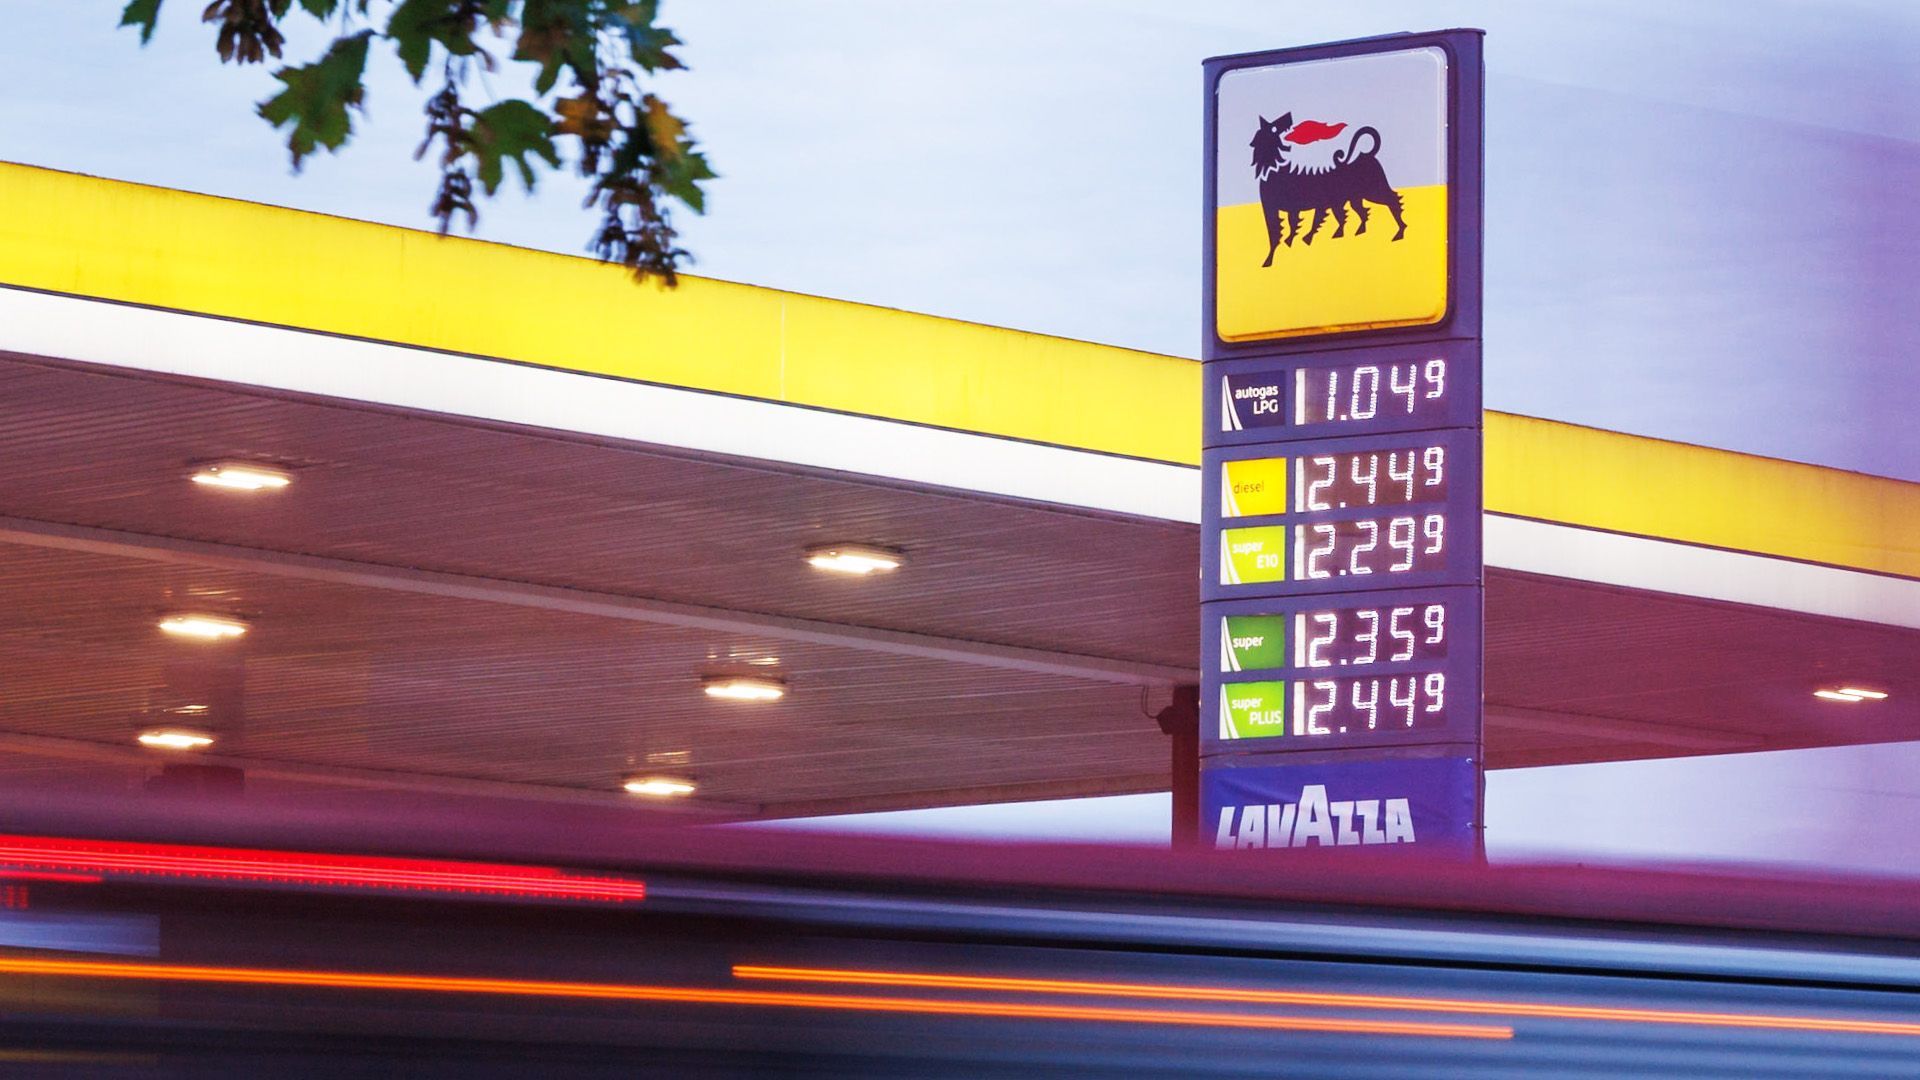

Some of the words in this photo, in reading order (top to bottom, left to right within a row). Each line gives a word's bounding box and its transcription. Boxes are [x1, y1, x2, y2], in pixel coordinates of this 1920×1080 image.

[1235, 385, 1278, 400] autogas
[1327, 359, 1445, 421] 1.049
[1253, 399, 1278, 415] LPG
[1308, 446, 1444, 511] 2.449
[1234, 480, 1264, 494] diesel
[1232, 541, 1264, 555] super
[1308, 514, 1444, 578] 2.299
[1257, 554, 1278, 569] E10
[1233, 635, 1264, 650] super
[1308, 605, 1445, 667] 2.359
[1231, 696, 1263, 710] super
[1308, 672, 1445, 735] 2.449
[1249, 710, 1281, 725] PLUS
[1215, 784, 1415, 849] LAVAZZA
